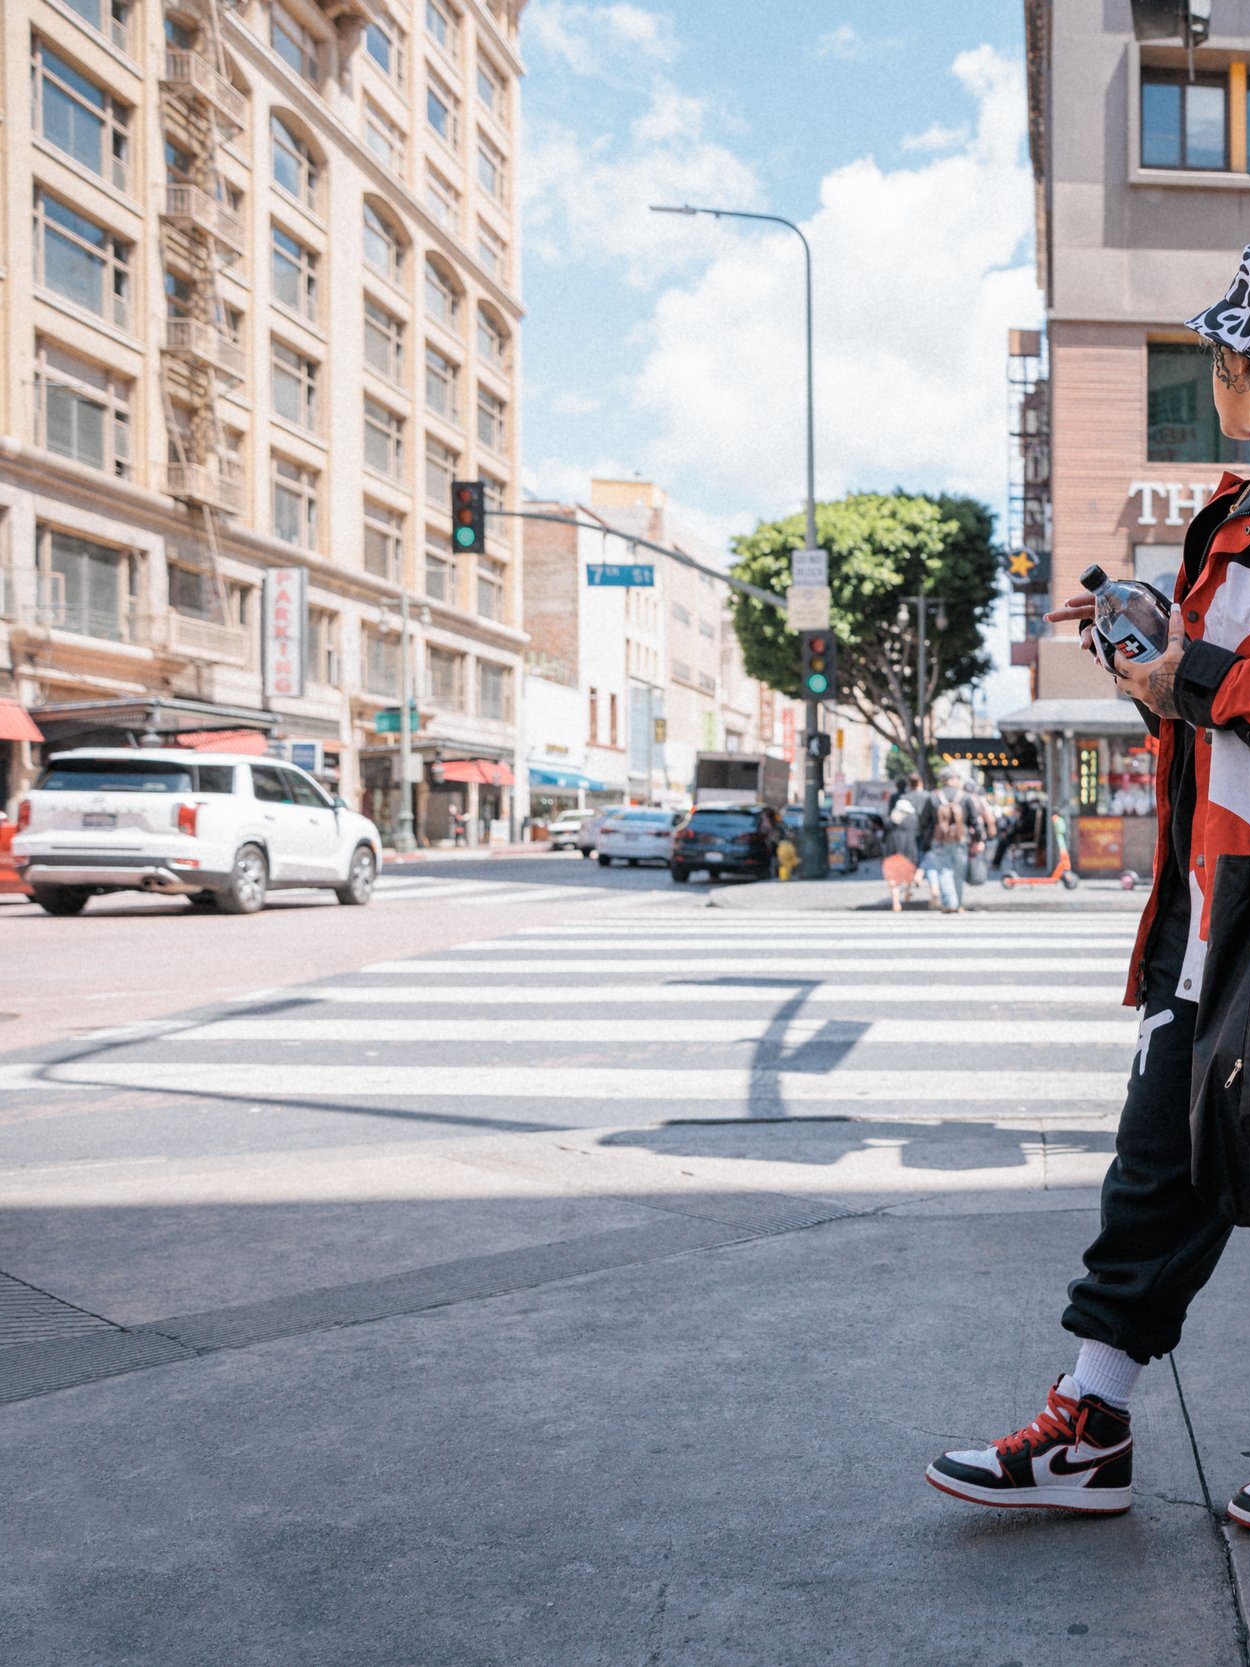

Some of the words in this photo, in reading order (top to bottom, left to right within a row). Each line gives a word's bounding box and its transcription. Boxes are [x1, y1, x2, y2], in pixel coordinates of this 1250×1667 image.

[1128, 481, 1217, 525] TH
[588, 566, 620, 585] 7th
[632, 567, 652, 584] St
[274, 571, 293, 693] PARKING
